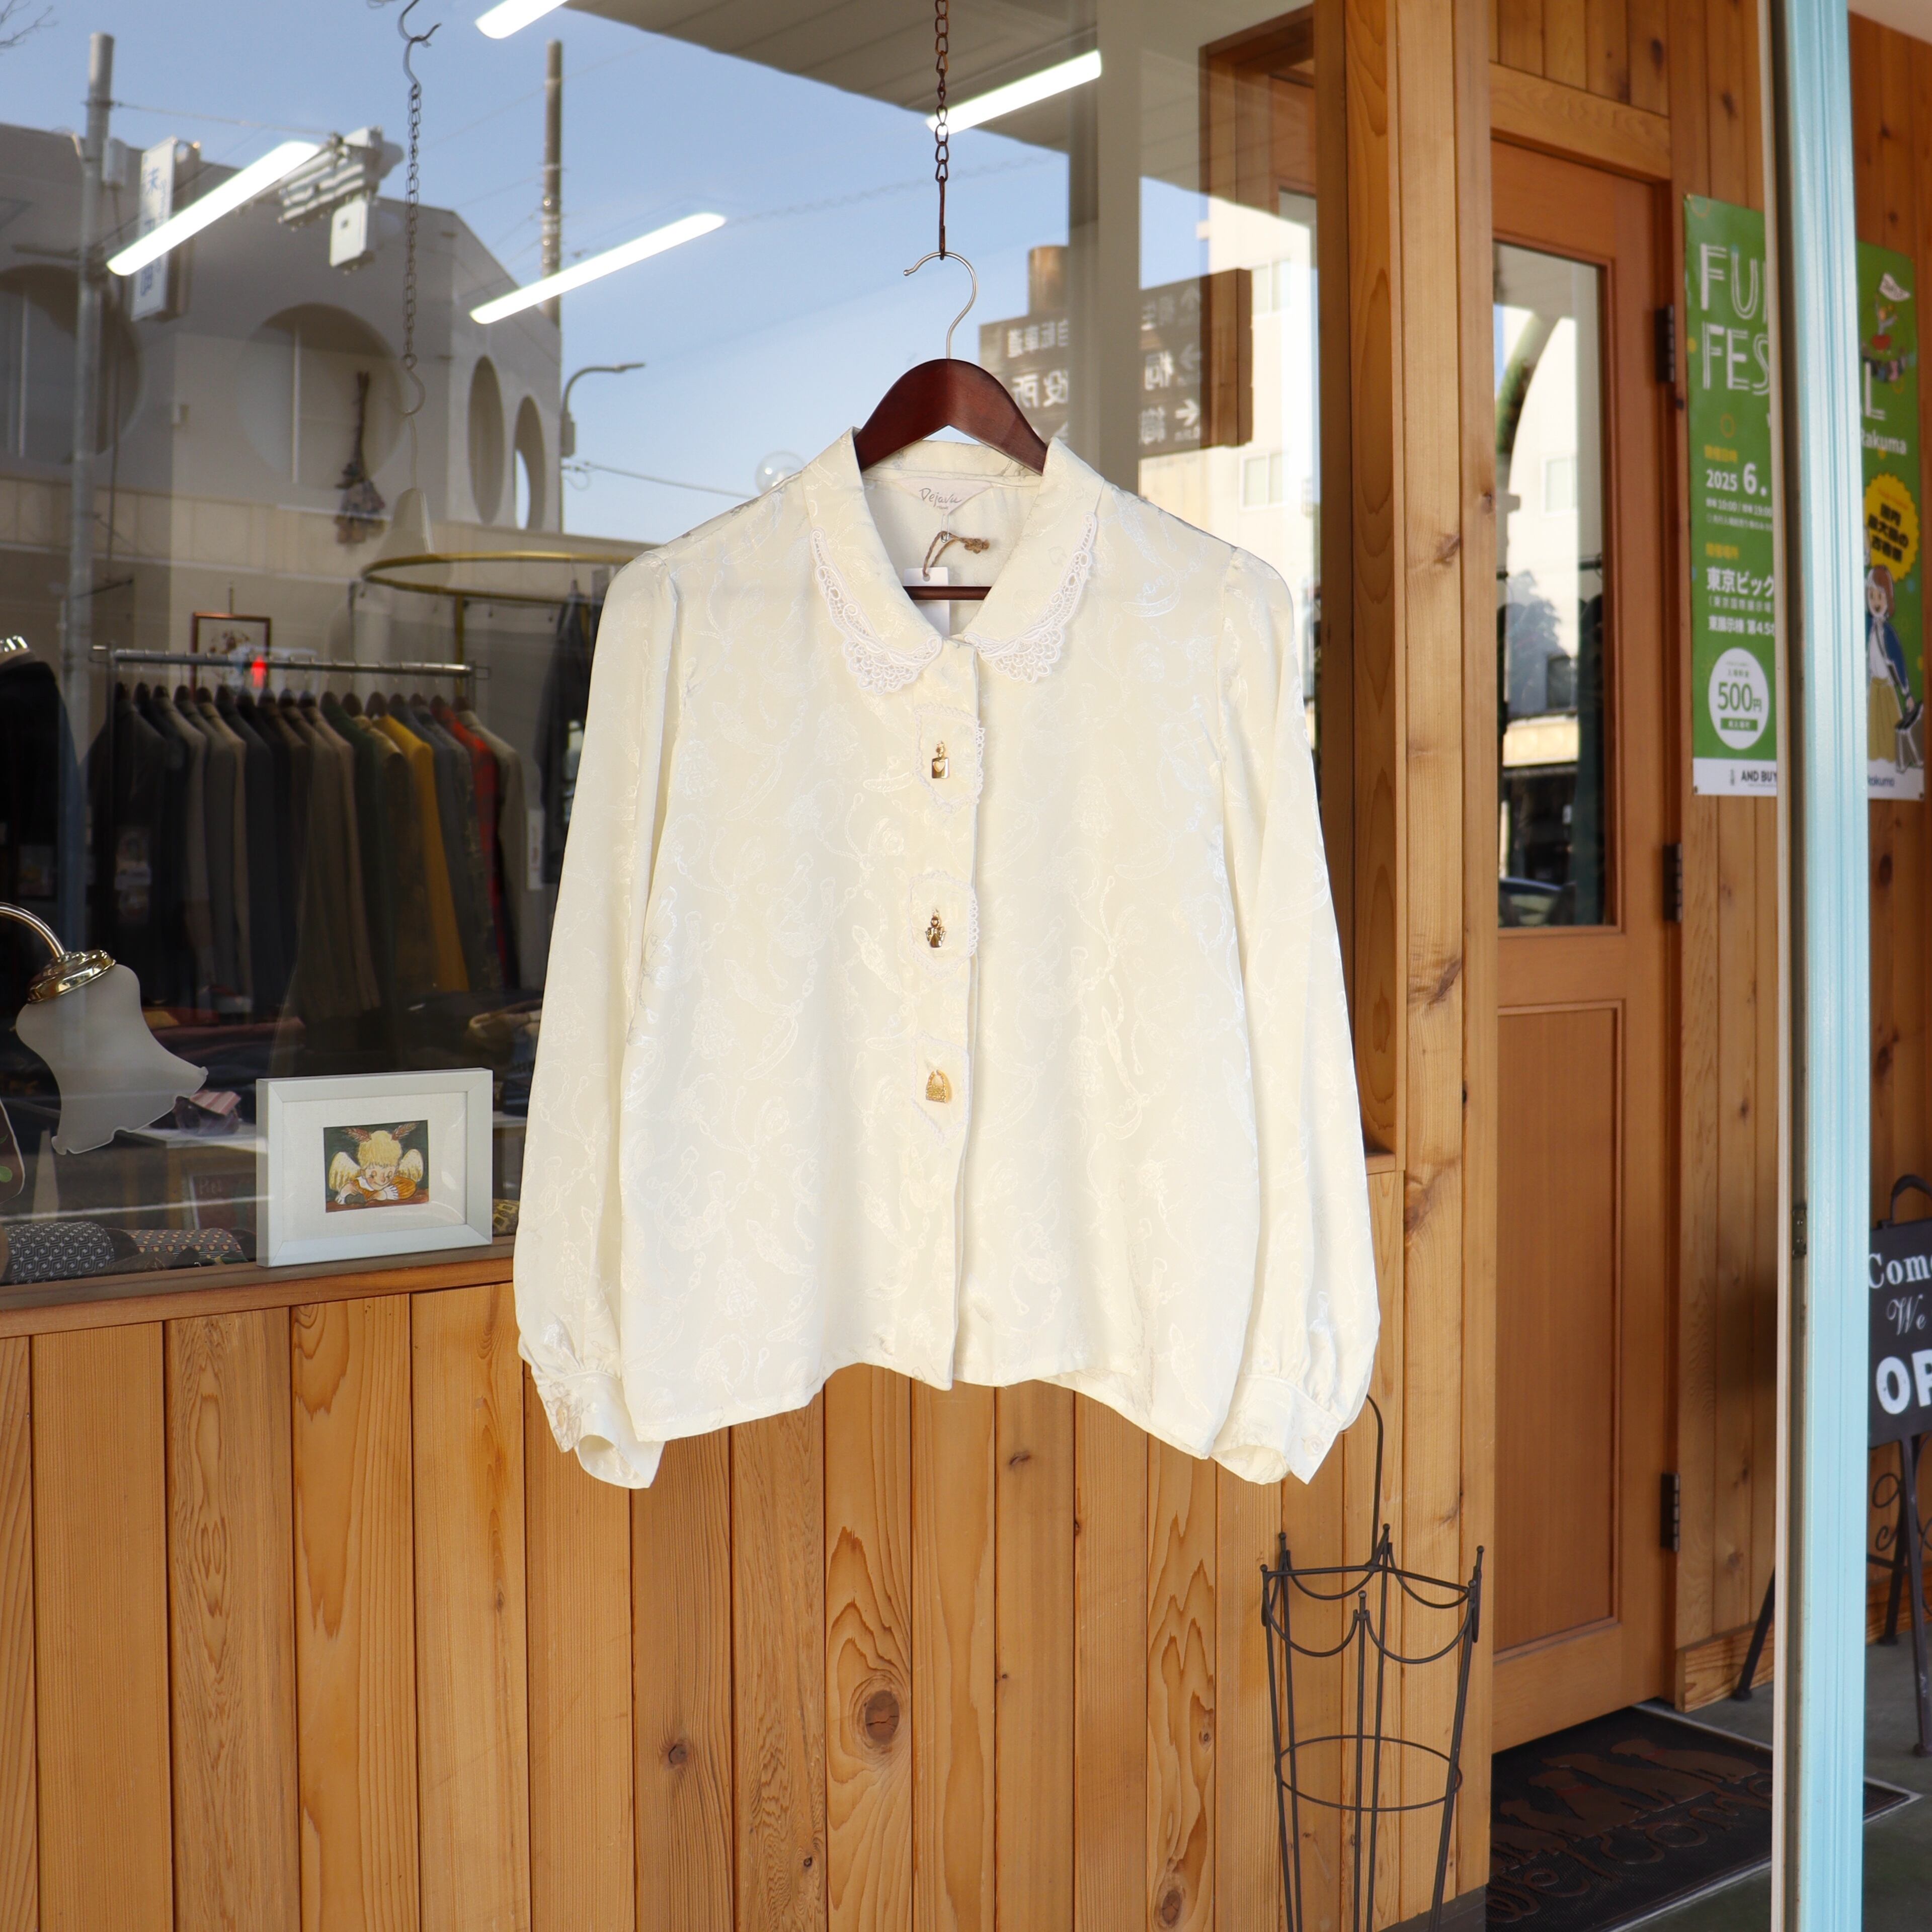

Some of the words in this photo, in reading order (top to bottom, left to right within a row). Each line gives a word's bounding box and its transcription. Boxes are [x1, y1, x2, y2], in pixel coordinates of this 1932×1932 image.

[1700, 243, 1769, 323] FU
[1706, 468, 1738, 493] 2025
[1741, 770, 1759, 782] AND
[1869, 1252, 1932, 1289] Com
[1887, 1294, 1926, 1336] We
